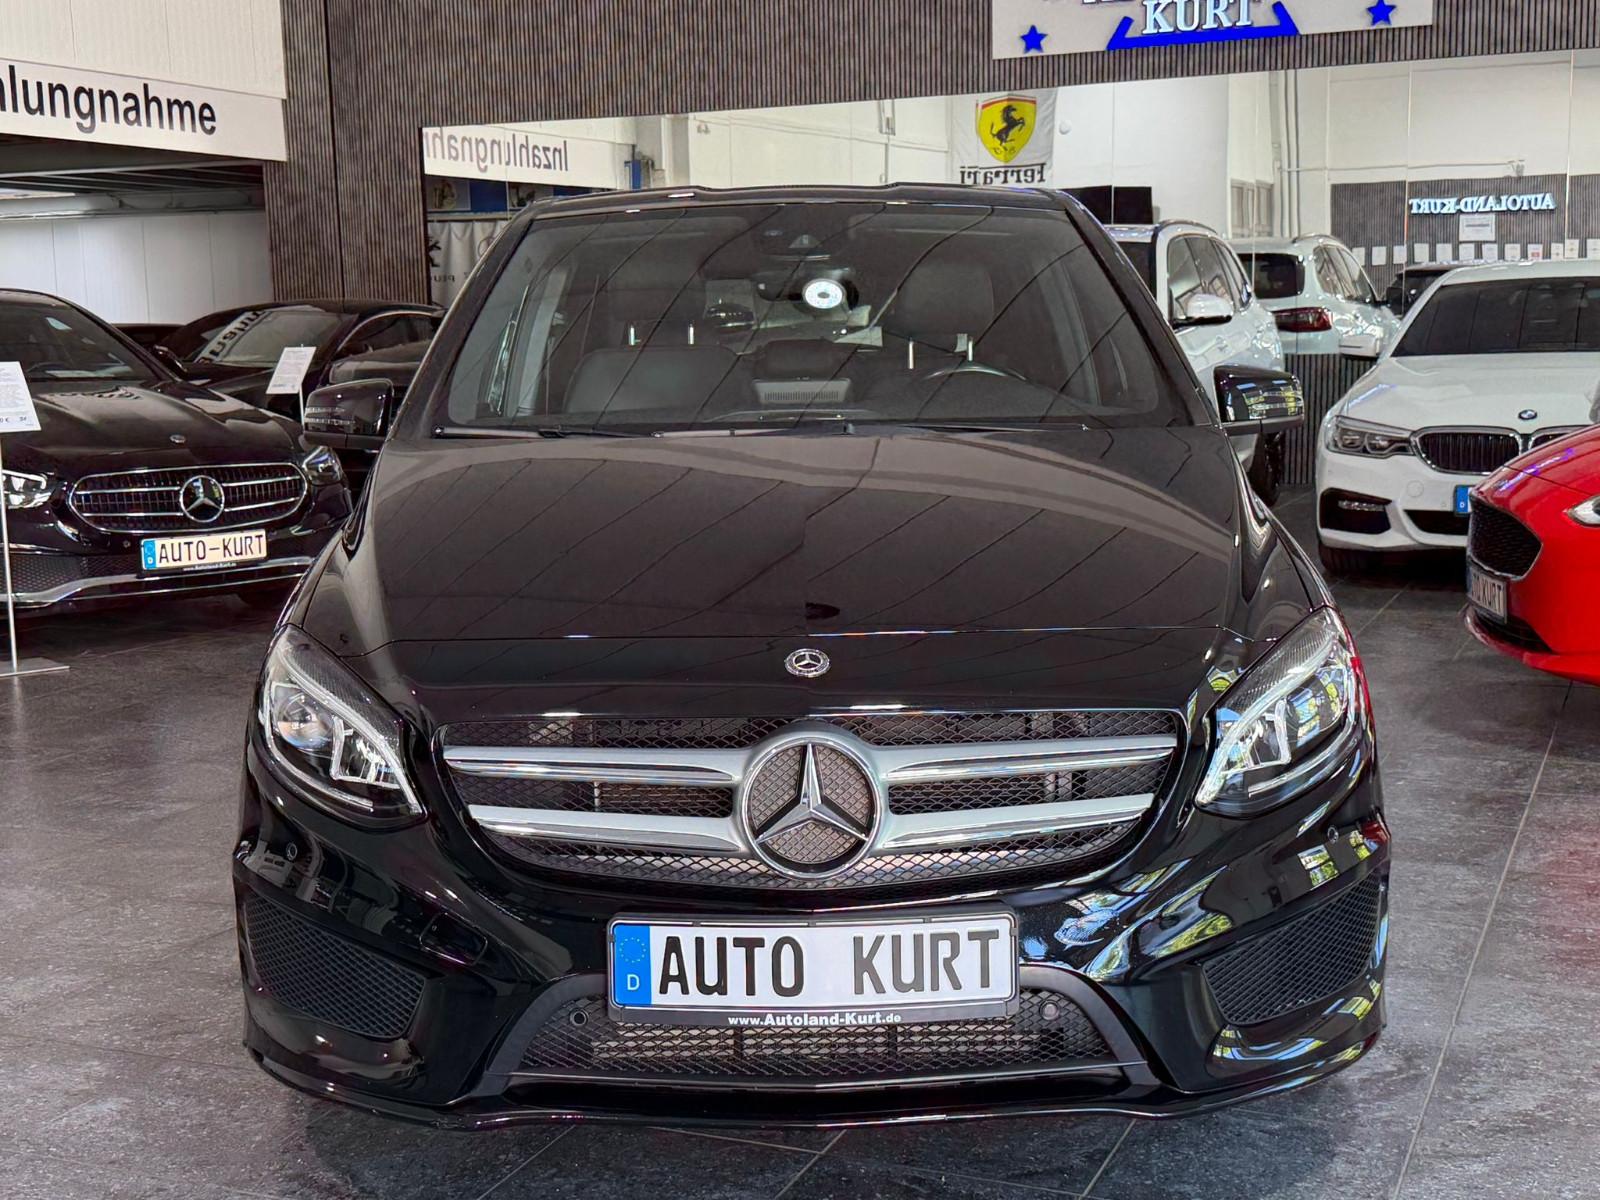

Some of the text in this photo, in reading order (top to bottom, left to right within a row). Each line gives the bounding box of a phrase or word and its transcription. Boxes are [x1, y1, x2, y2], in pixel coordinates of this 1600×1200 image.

[1142, 0, 1252, 34] KURT
[158, 535, 263, 563] AUTO-KURT
[627, 929, 999, 997] D AUTO KURT
[728, 1012, 901, 1026] www.Autoland-Kurt.de
